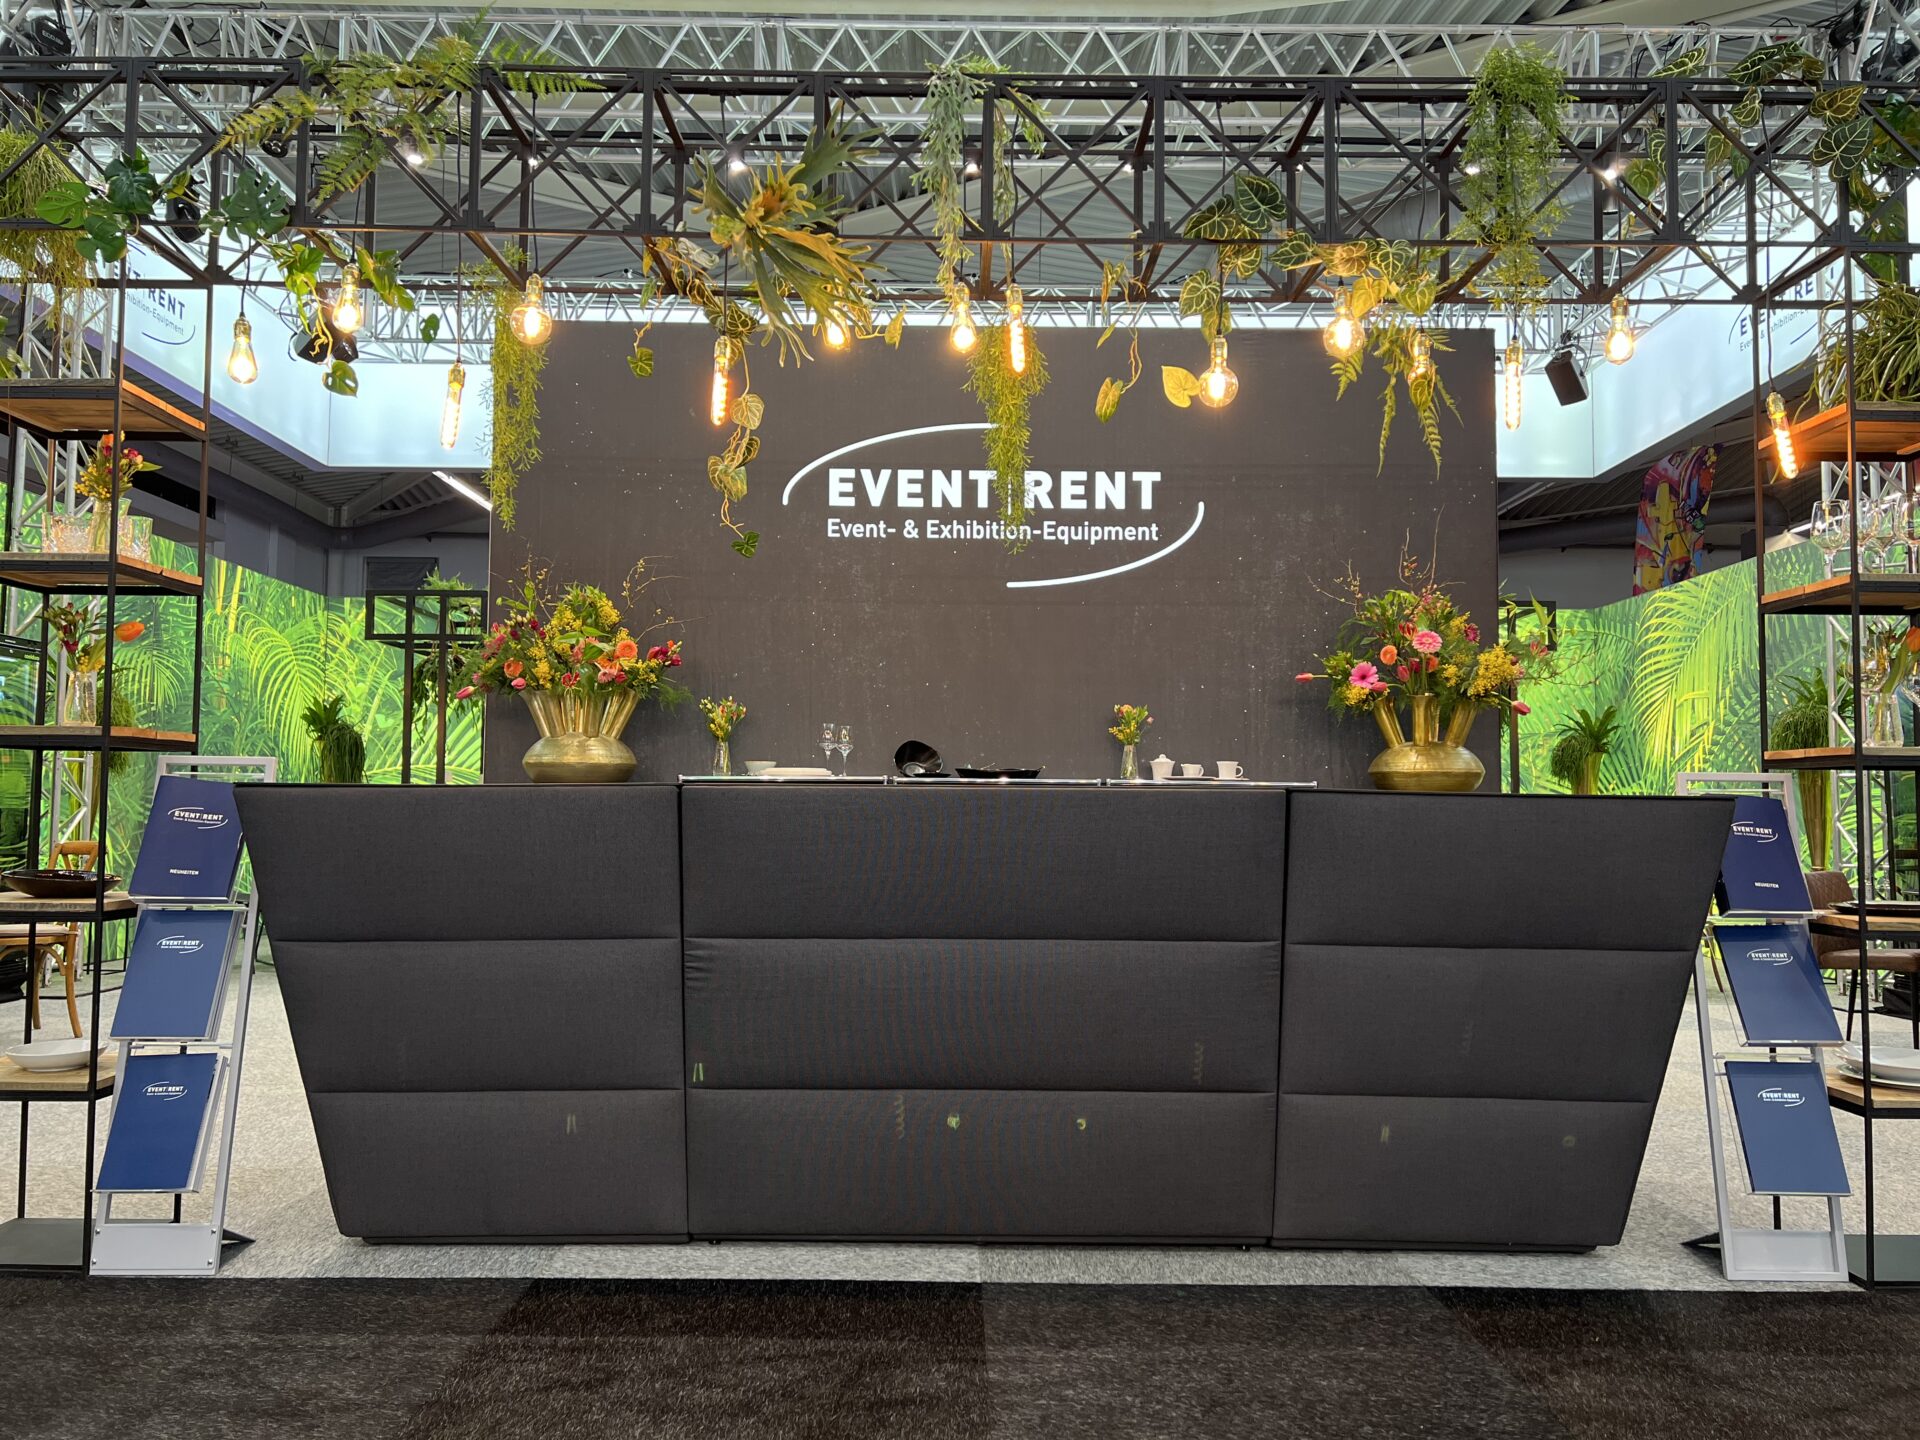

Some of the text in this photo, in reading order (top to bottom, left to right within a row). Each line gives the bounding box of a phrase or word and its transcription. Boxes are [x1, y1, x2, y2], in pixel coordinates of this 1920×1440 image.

[828, 468, 1162, 510] EVENT RENT
[827, 518, 1159, 545] Event- & Exhibition-Equipment
[174, 810, 201, 819] EVENT
[202, 813, 224, 821] RENT
